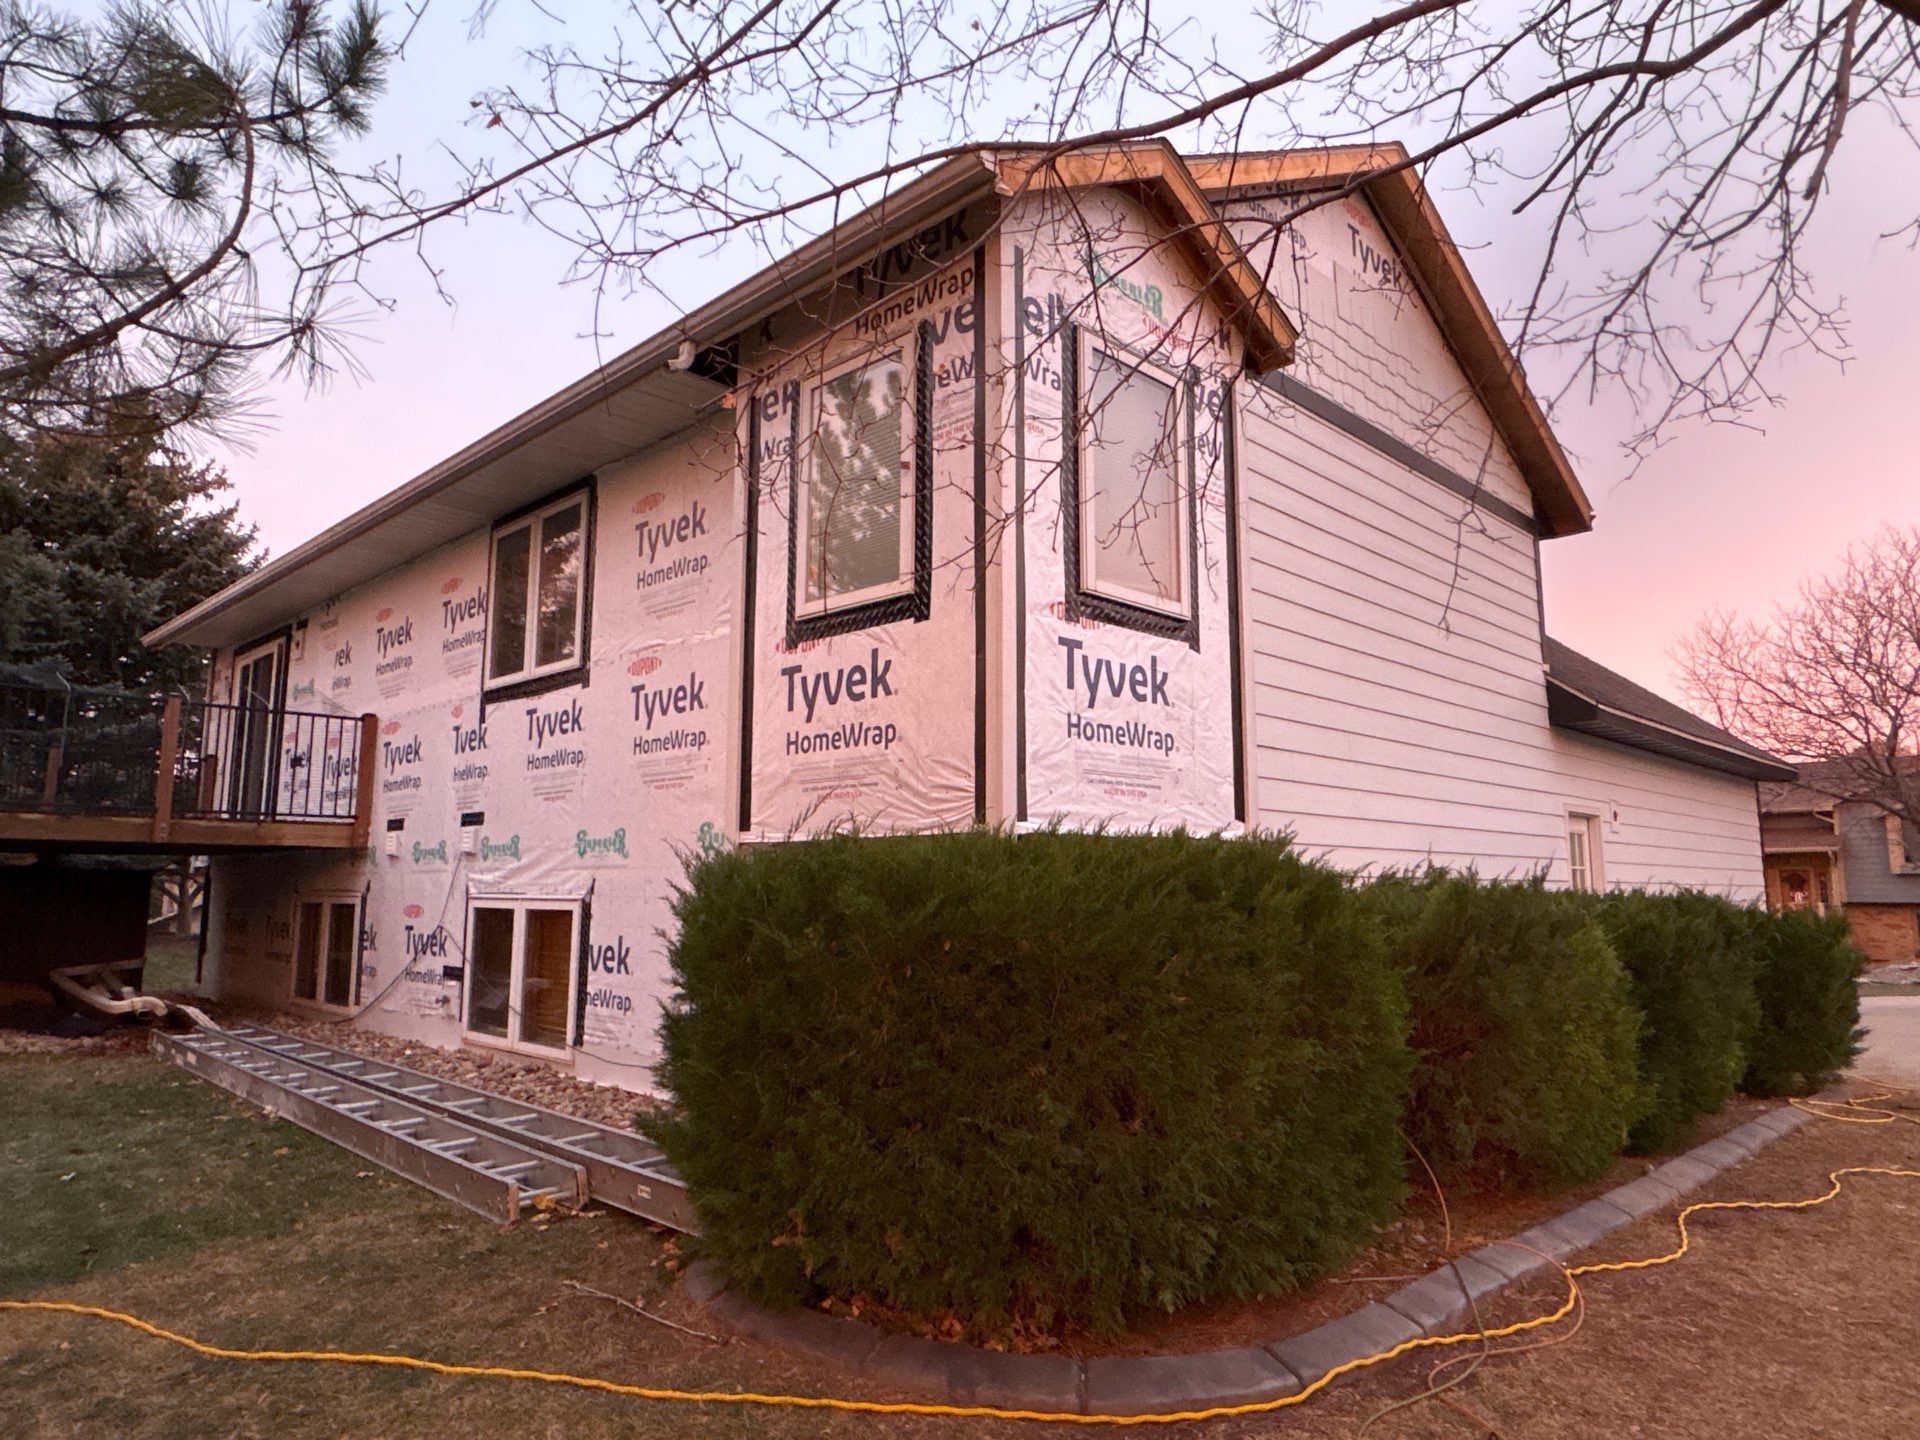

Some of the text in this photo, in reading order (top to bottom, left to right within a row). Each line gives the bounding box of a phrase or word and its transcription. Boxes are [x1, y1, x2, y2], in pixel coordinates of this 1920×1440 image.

[1347, 222, 1402, 288] Tyvek
[855, 267, 975, 336] HomeWrap
[635, 500, 707, 564] Tyvek
[637, 554, 708, 590] HomeWrap
[443, 587, 487, 633] Tyvek
[377, 616, 413, 658] Tyvek
[376, 654, 413, 676] HomeWrap
[781, 648, 893, 723] Tyvek
[1058, 636, 1170, 709] Tyvek
[631, 672, 705, 730] Tyvek
[526, 699, 582, 749] Tyvek
[633, 729, 707, 756] HomeWrap
[786, 722, 897, 756] HomeWrap
[1068, 713, 1174, 757] HomeWrap
[384, 735, 422, 775] Tyvek
[527, 749, 584, 771] HomeWrap
[383, 775, 422, 793] HomeWrap
[405, 924, 448, 963] Tyvek
[405, 967, 444, 986] HomeWra
